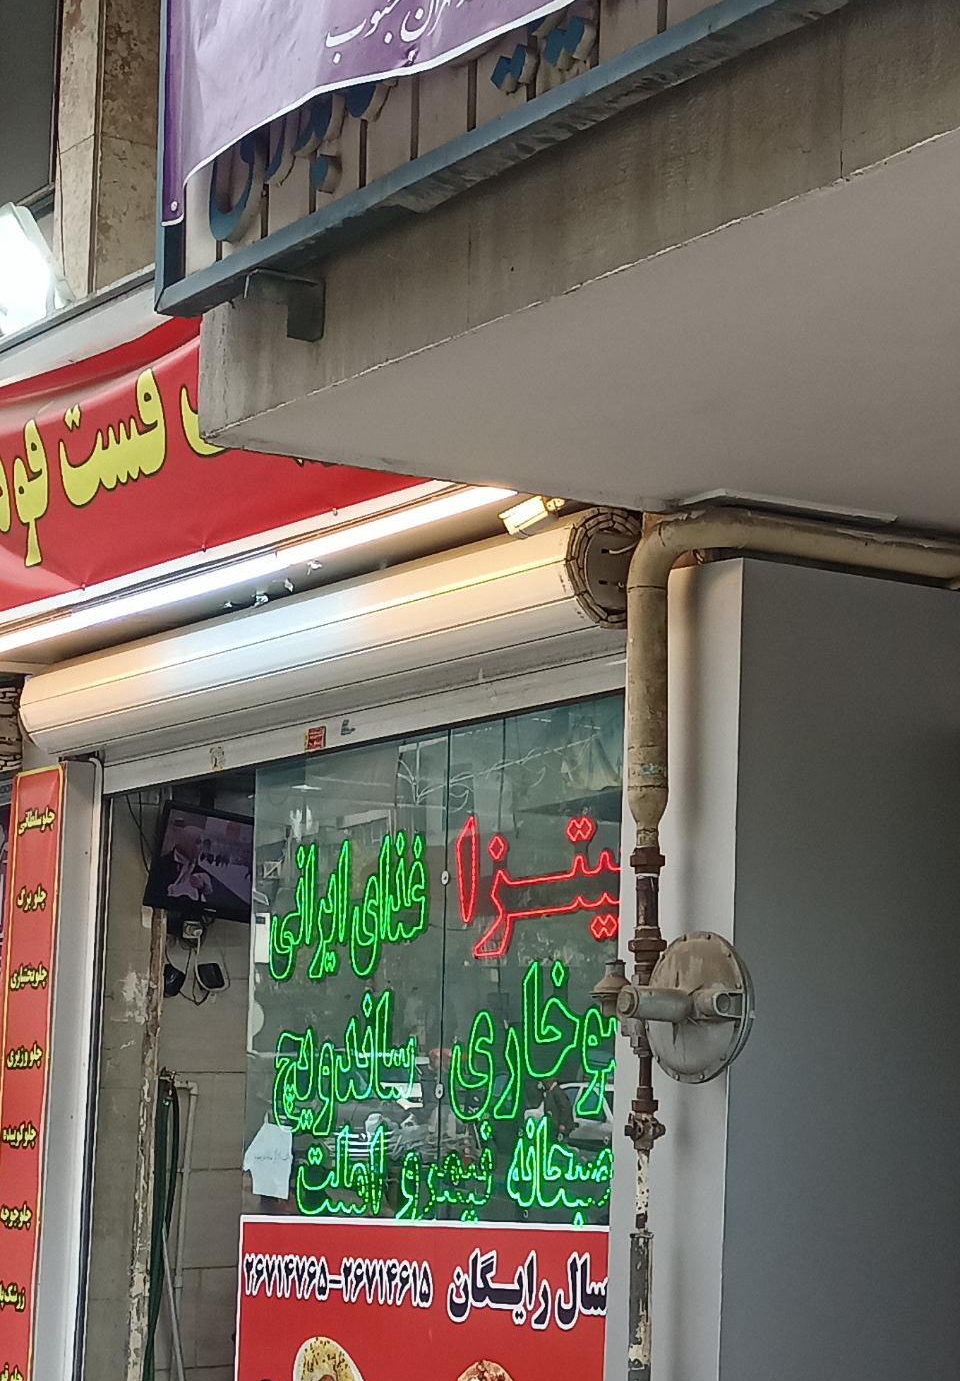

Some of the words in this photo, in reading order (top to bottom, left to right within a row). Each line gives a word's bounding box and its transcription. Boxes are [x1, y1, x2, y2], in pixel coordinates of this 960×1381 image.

[59, 367, 167, 508] فست
[269, 839, 350, 979] ایرانی
[349, 830, 429, 976] غذای
[455, 814, 622, 958] یتزا
[273, 990, 417, 1136] ساندویچ
[448, 1248, 550, 1329] رایگان
[555, 1252, 608, 1329] سال
